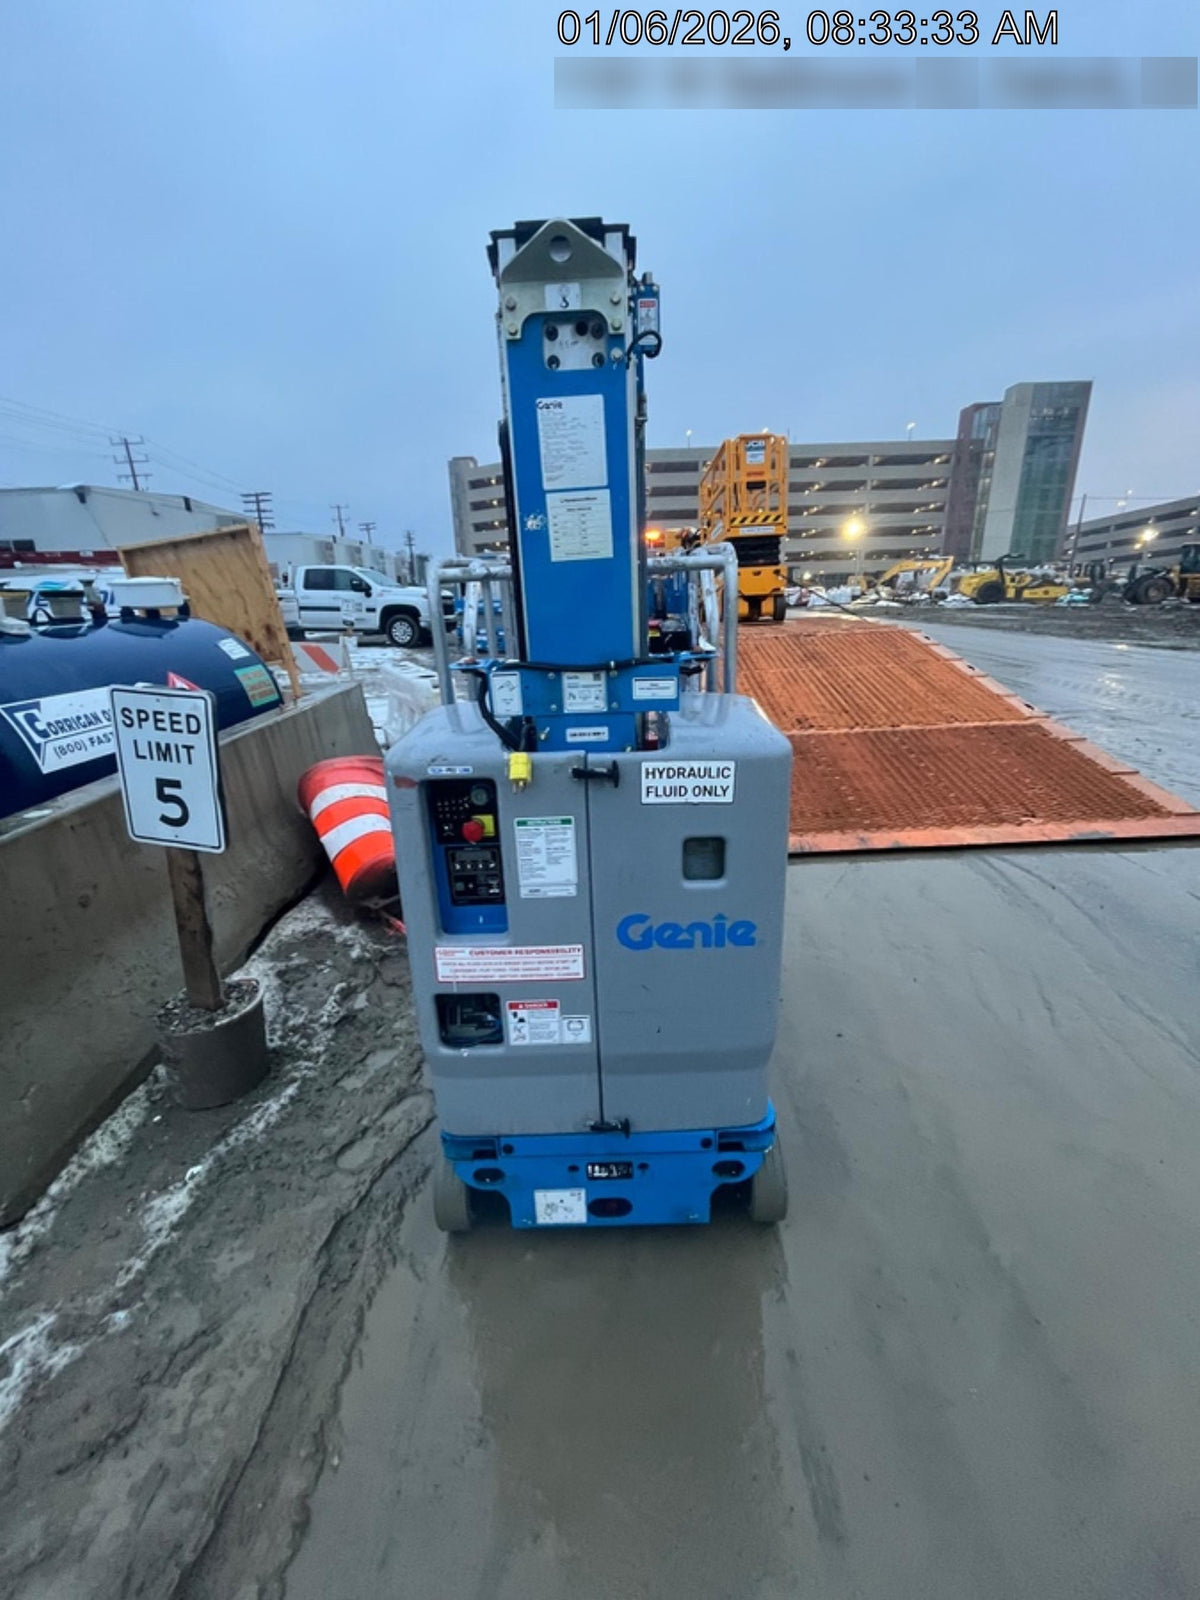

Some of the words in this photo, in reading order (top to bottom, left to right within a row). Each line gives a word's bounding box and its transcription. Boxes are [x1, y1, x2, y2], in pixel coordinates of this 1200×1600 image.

[23, 711, 103, 738] CORRIGAN
[121, 707, 201, 735] SPEED
[53, 739, 87, 760] (800)
[134, 739, 195, 765] LIMIT
[645, 766, 732, 779] HYDRAULIC
[155, 777, 190, 828] 5
[646, 785, 688, 798] FLUID
[692, 785, 730, 797] ONLY
[617, 912, 757, 950] Genie
